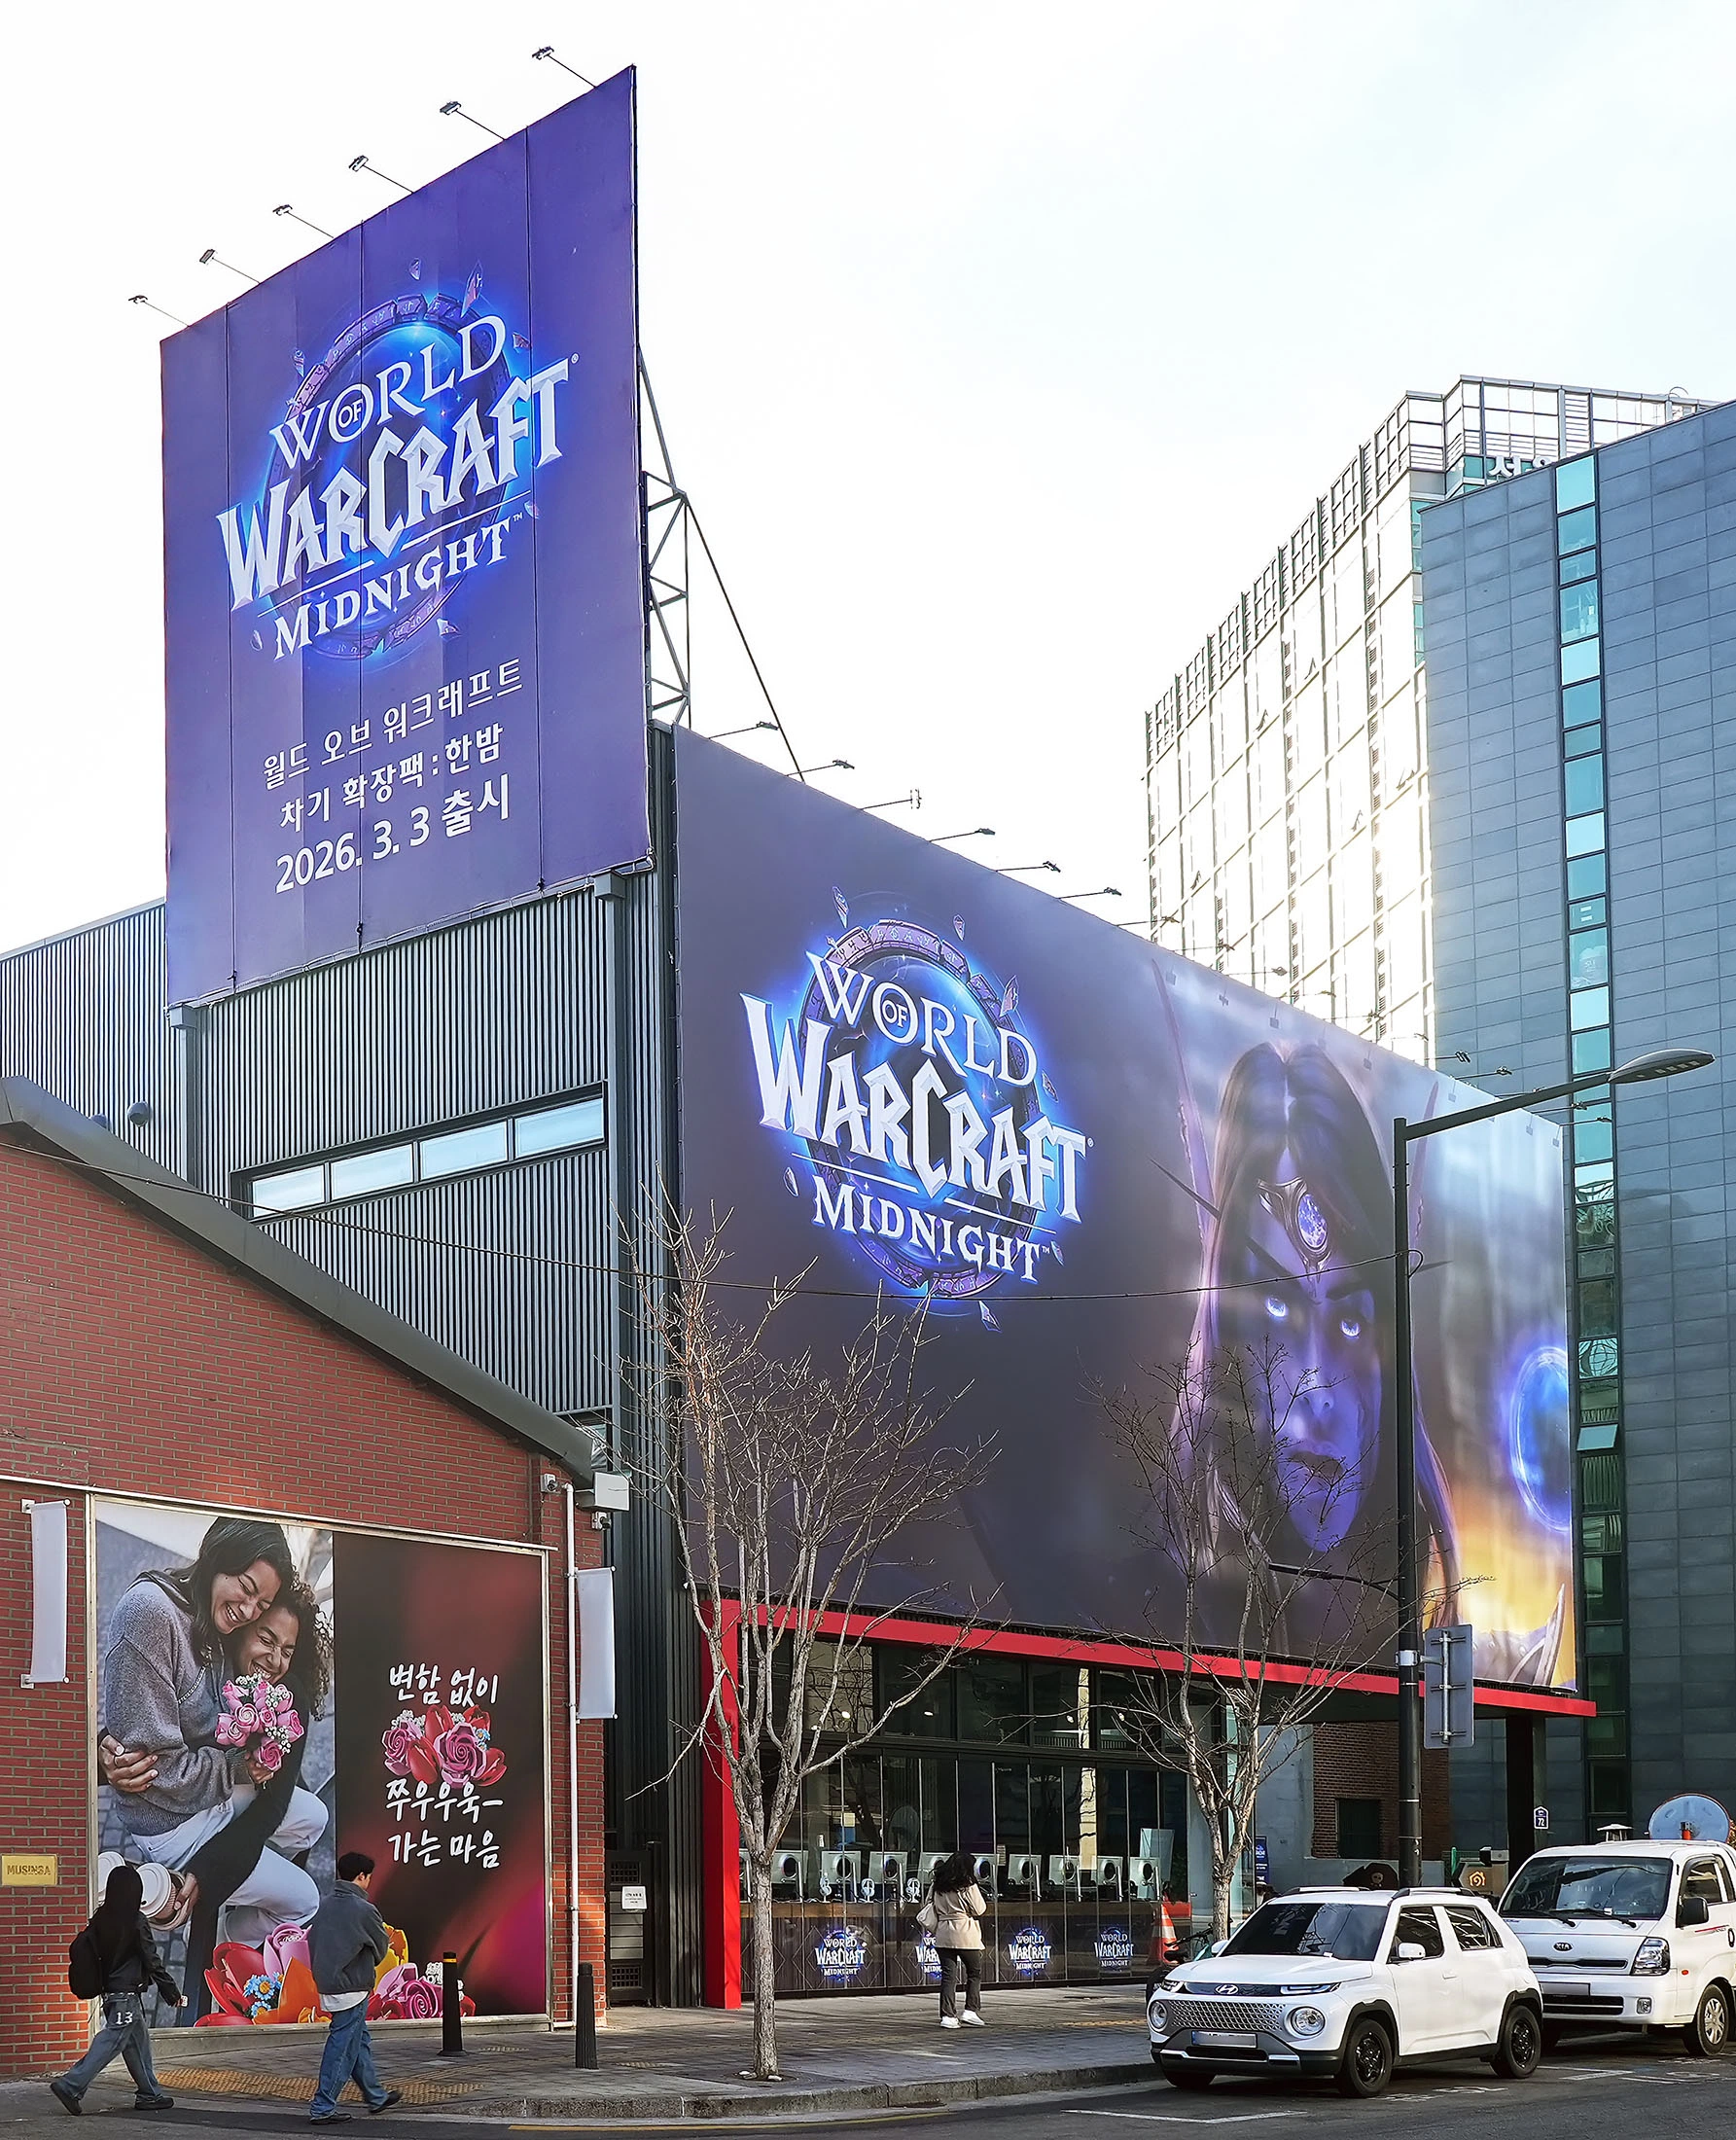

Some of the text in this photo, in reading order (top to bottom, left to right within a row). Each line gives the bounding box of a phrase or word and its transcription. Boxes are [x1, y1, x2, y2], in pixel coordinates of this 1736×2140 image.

[269, 314, 507, 470] WORLD
[337, 398, 364, 429] OF
[215, 357, 570, 611] WARCRAFT
[273, 517, 512, 661] MIDNIGHT
[264, 658, 523, 791] 월드 오브 워크래프트
[280, 787, 331, 833] 차기
[444, 723, 504, 775] 한밤
[275, 773, 510, 894] 2026. 3. 3 출시
[805, 950, 1038, 1087] WORLD
[881, 998, 908, 1028] OF
[739, 992, 1088, 1224] WARCRAFT
[811, 1174, 1043, 1283] MIDNIGHT
[389, 1663, 499, 1707] 변함 없이
[7, 1865, 52, 1875] MUSINSA
[388, 1829, 501, 1869] 가는 마음
[814, 1947, 867, 1967] WARCRAFT
[823, 1938, 858, 1948] WORLD
[1008, 1944, 1051, 1962] WARCRAFT
[1094, 1942, 1135, 1958] WARCRAFT
[1100, 1934, 1128, 1943] WORLD
[116, 2012, 132, 2024] 13
